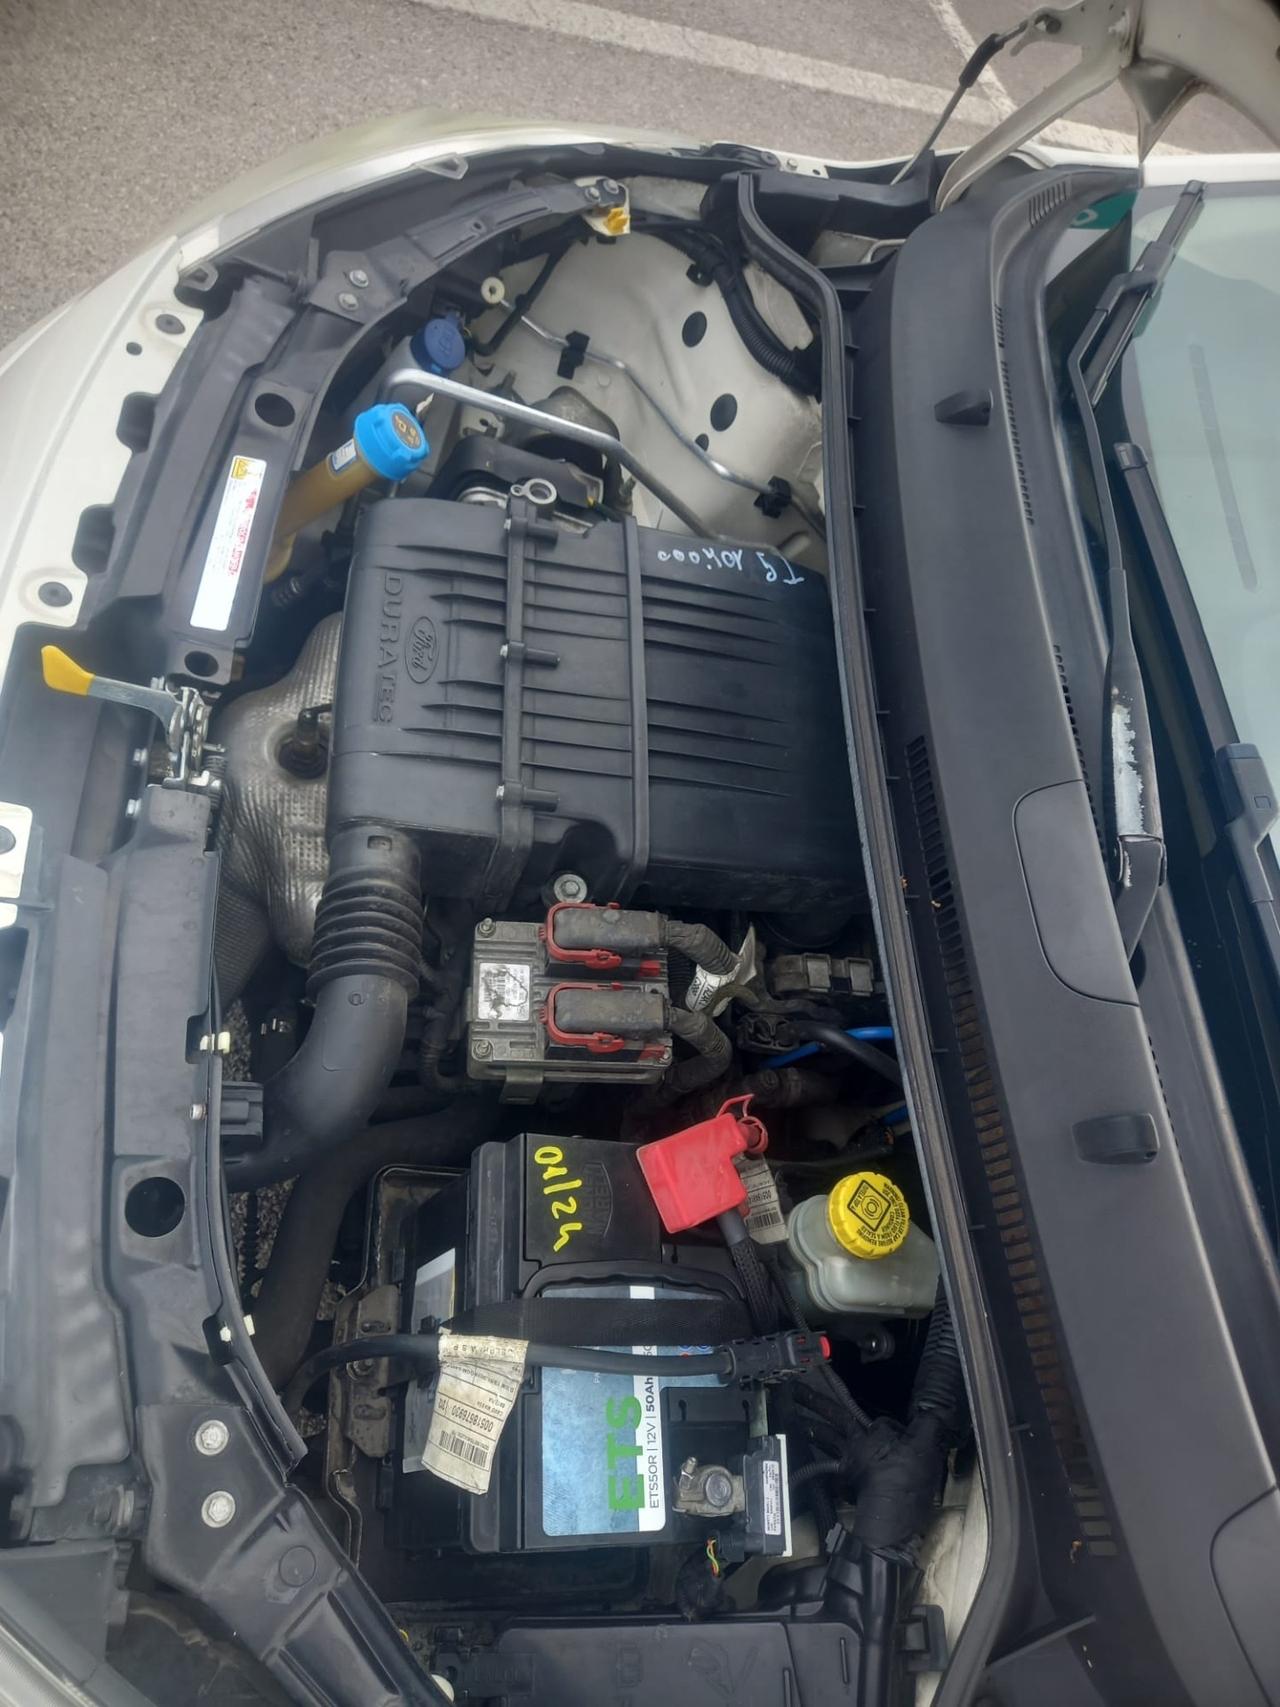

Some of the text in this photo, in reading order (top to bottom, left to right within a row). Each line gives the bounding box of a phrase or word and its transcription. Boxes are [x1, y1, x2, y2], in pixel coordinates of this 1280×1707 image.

[376, 570, 403, 723] DURATEC
[606, 1395, 645, 1509] ETS
[644, 1377, 660, 1509] ETS50R 12V 50Ah
